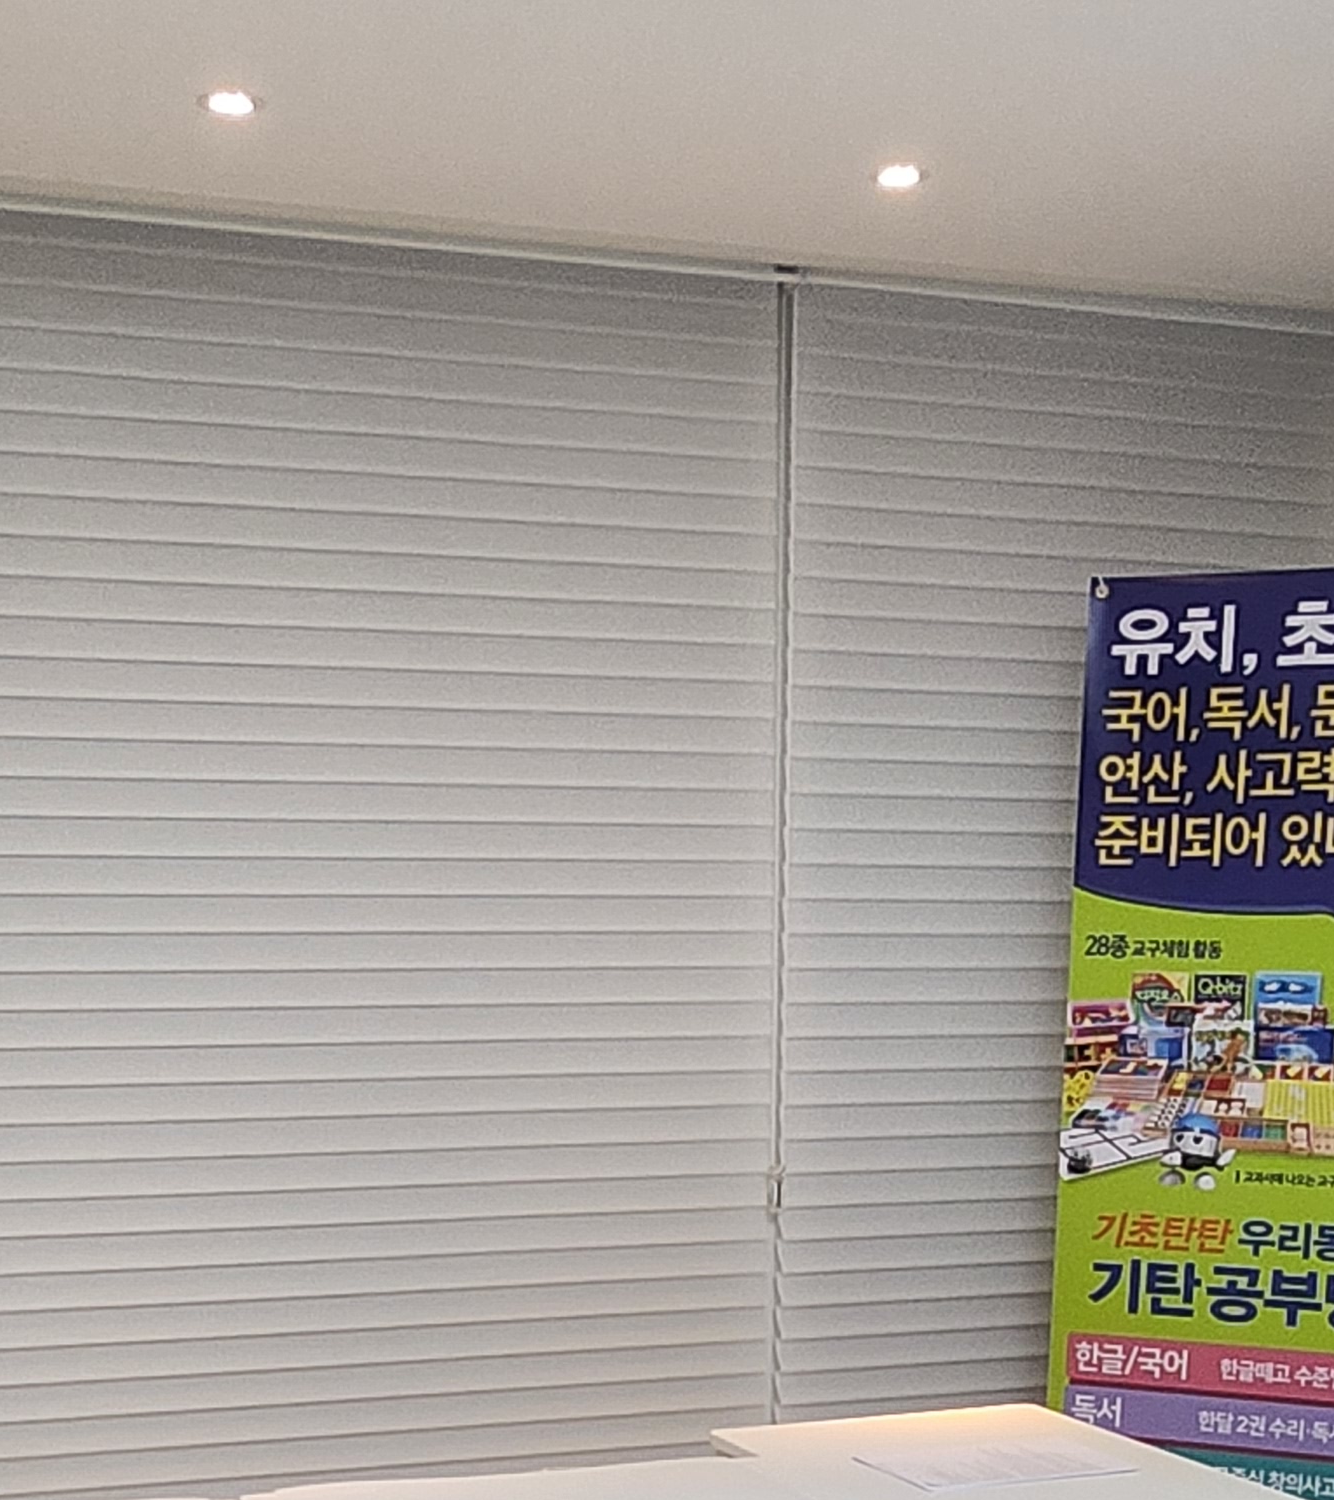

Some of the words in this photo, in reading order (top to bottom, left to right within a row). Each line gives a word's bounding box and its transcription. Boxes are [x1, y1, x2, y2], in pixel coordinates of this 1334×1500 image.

[1110, 604, 1259, 675] 유치,
[1101, 686, 1200, 742] 국어,
[1203, 683, 1301, 741] 독서,
[1098, 750, 1194, 806] 연산,
[1094, 812, 1265, 867] 준비되어
[1084, 934, 1130, 959] 28종
[1285, 1172, 1316, 1187] 나오는
[1091, 1212, 1234, 1255] 기초탄탄
[1075, 1341, 1189, 1380] 한글/국어
[1070, 1393, 1122, 1427] 독서
[1198, 1411, 1234, 1434] 한달
[1236, 1415, 1266, 1437] 2권
